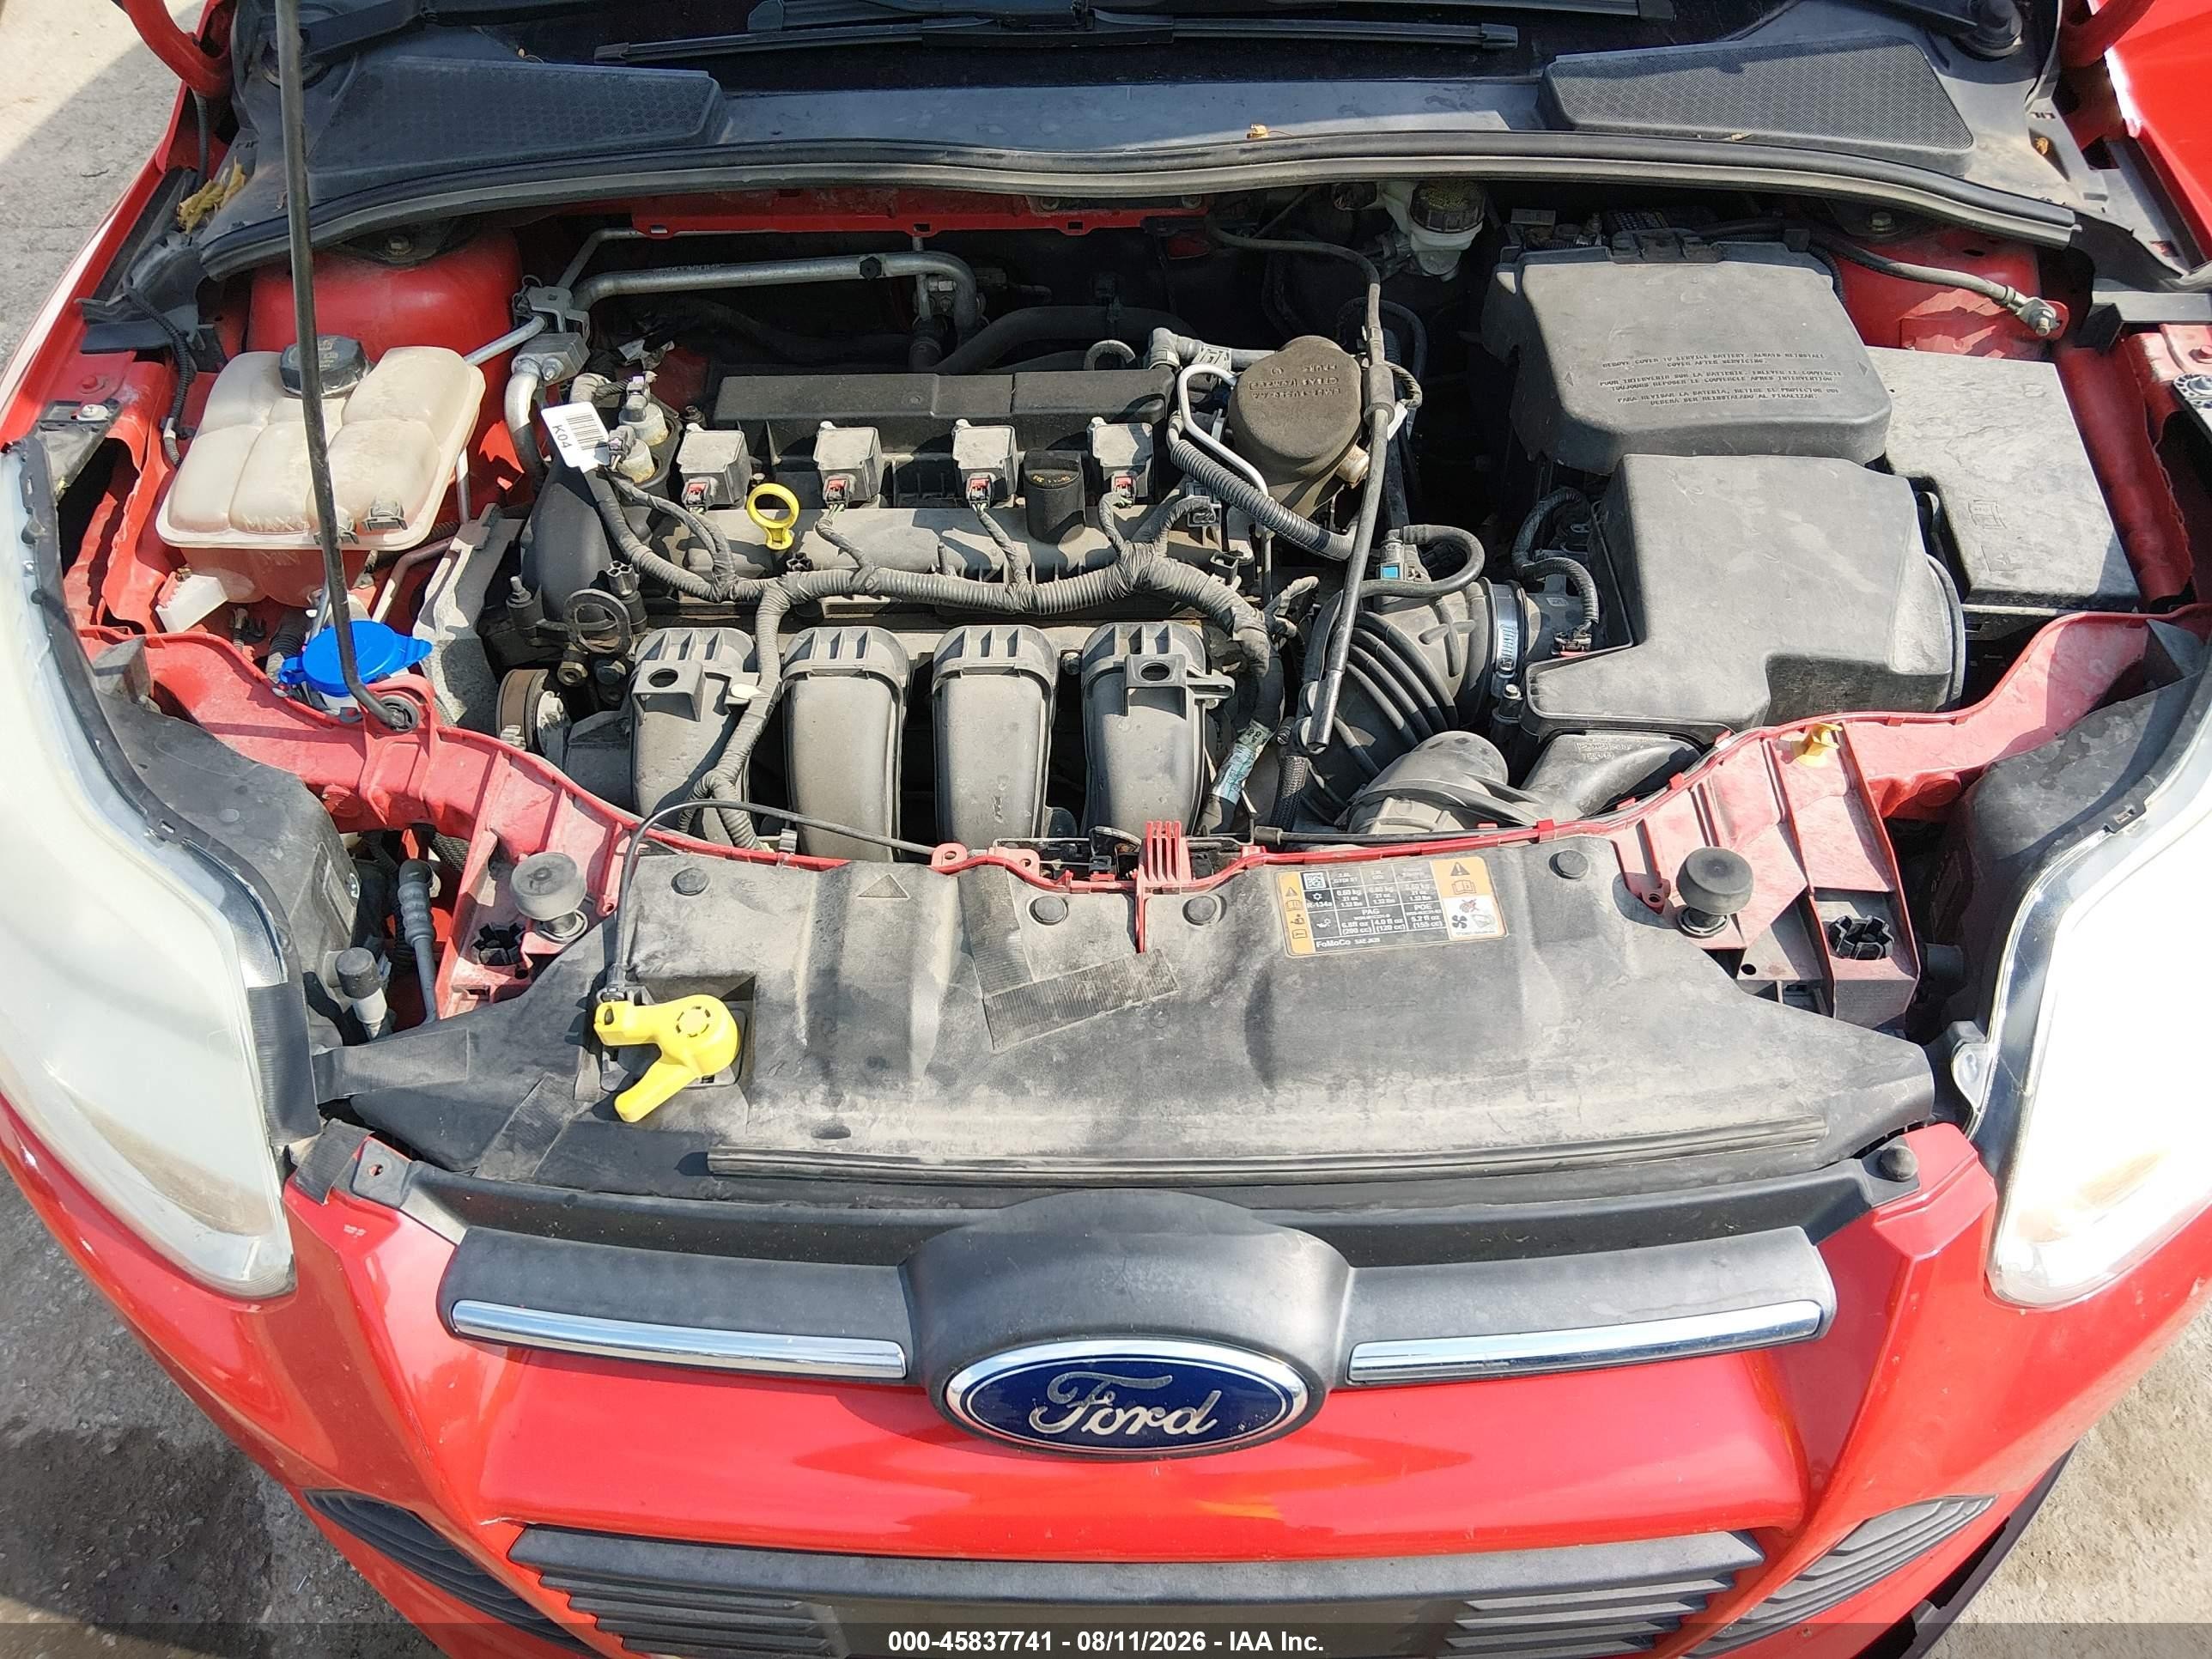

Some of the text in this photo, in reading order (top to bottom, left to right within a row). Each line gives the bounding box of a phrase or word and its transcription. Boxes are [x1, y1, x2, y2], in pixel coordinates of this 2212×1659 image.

[552, 425, 573, 448] K04
[1316, 939, 1352, 948] FoMoCo
[1029, 1371, 1222, 1435] Ford
